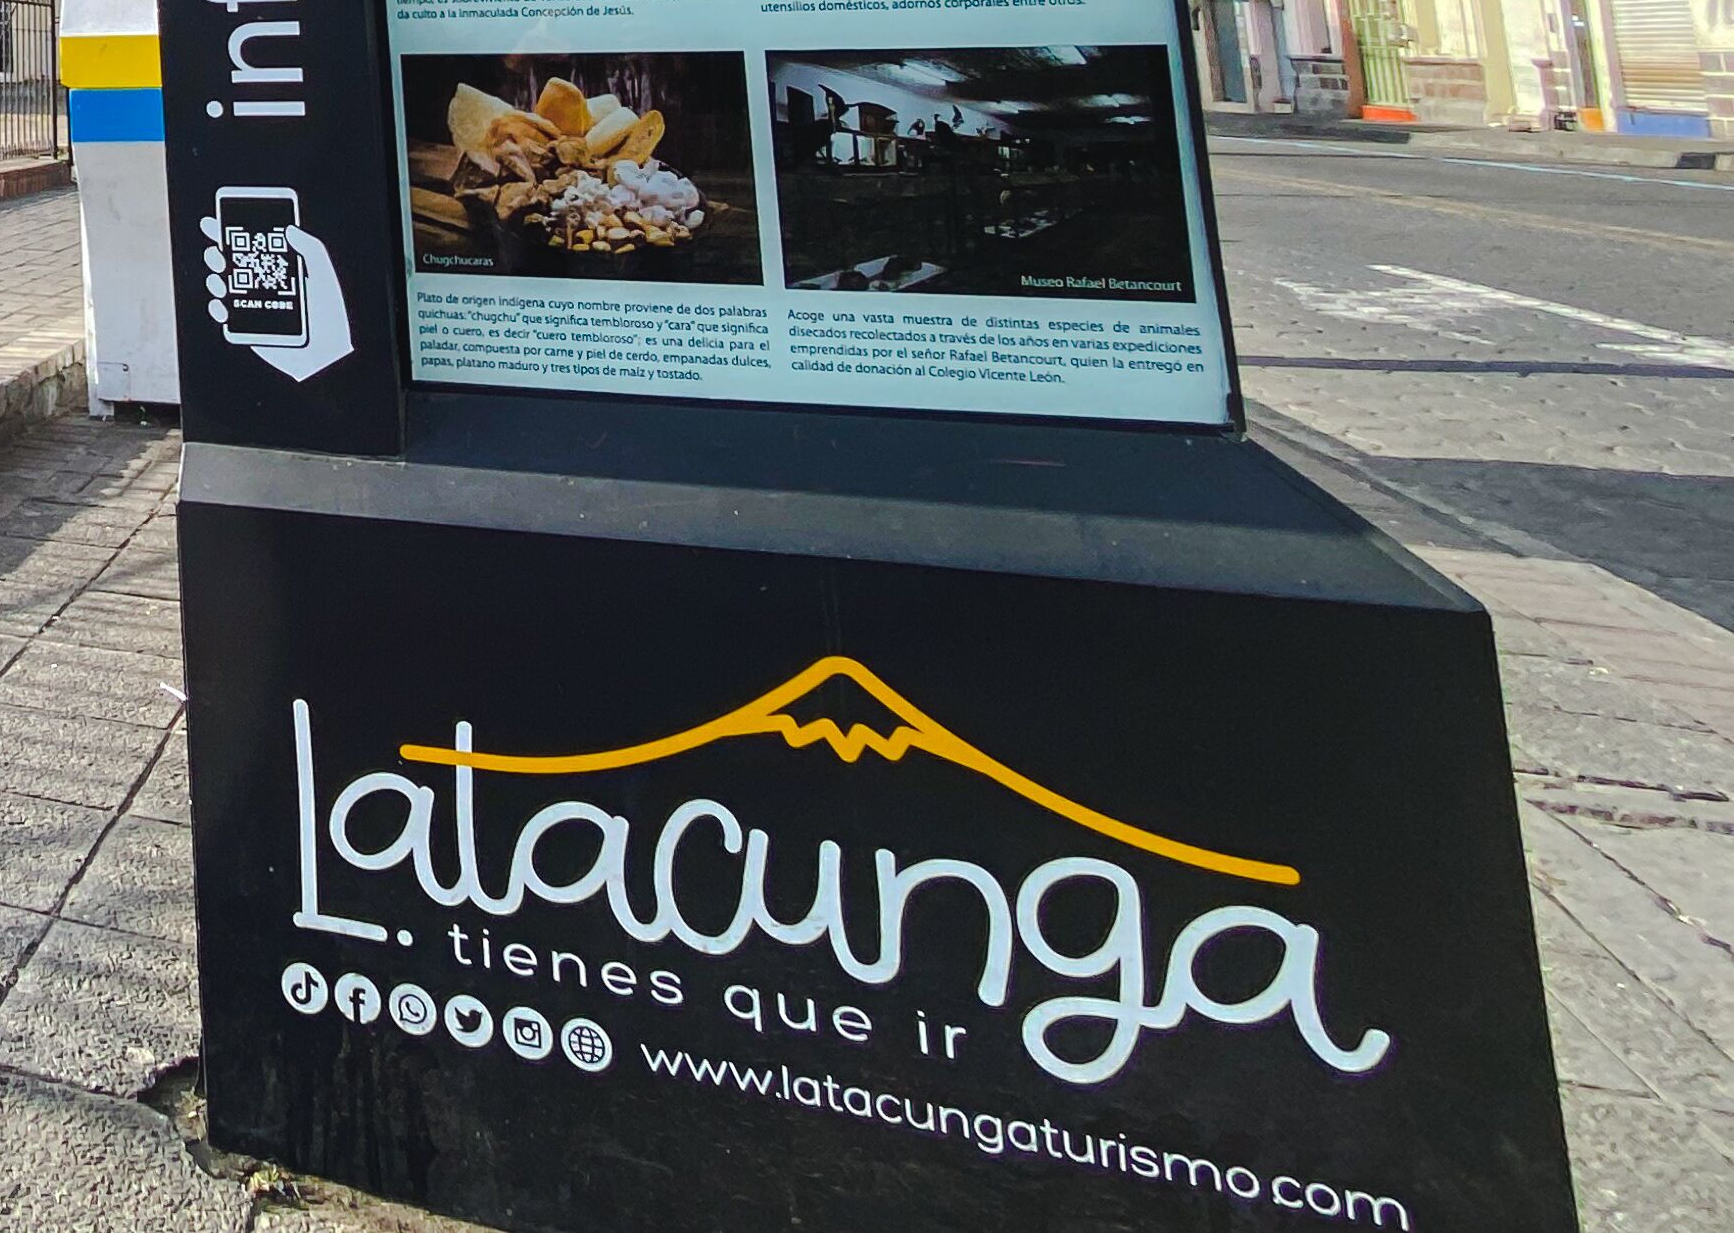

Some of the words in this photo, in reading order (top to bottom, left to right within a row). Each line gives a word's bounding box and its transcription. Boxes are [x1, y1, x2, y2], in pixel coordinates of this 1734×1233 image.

[412, 7, 437, 19] culto
[458, 6, 518, 19] Inmaculada
[520, 5, 584, 19] Concepción
[760, 0, 815, 13] utensilios
[422, 253, 494, 267] Chugchucaras
[1021, 275, 1064, 287] Museo
[1066, 277, 1106, 289] Rafael
[1109, 278, 1182, 291] Betancourt
[233, 299, 262, 308] SCAN
[416, 291, 442, 304] Plato
[461, 293, 495, 308] origen
[498, 294, 545, 310] indígena
[548, 300, 574, 312] cuyo
[577, 299, 620, 312] nombre
[624, 301, 673, 314] proviene
[694, 303, 715, 316] dos
[718, 305, 767, 319] palabras
[522, 314, 542, 326] que
[544, 313, 588, 327] significa
[590, 316, 654, 329] tembloroso
[696, 323, 718, 334] que
[721, 321, 768, 336] significa
[787, 308, 824, 323] Acoge
[832, 313, 855, 322] una
[862, 313, 894, 324] vasta
[902, 315, 953, 326] muestra
[985, 316, 1040, 330] distintas
[1048, 320, 1104, 334] especies
[1138, 323, 1200, 336] animales
[418, 322, 438, 337] piel
[503, 326, 530, 339] decir
[661, 337, 683, 347] una
[687, 336, 724, 349] delicia
[729, 341, 754, 352] para
[788, 324, 846, 339] disecados
[849, 328, 926, 342] recolectados
[938, 332, 976, 344] través
[997, 334, 1015, 346] los
[1018, 335, 1049, 348] años
[1071, 338, 1109, 350] varias
[1112, 340, 1201, 355] expediciones
[462, 343, 520, 356] compuesta
[523, 346, 541, 358] por
[544, 348, 573, 358] carne
[586, 347, 606, 361] piel
[662, 353, 728, 366] empanadas
[790, 344, 868, 357] emprendidas
[872, 348, 892, 360] por
[911, 348, 945, 360] señor
[949, 349, 987, 362] Rafael
[1070, 355, 1108, 369] quien
[1128, 359, 1182, 373] entregó
[456, 356, 495, 370] platano
[498, 359, 539, 372] maduro
[550, 362, 570, 374] tres
[572, 362, 600, 377] tipos
[619, 365, 645, 378] maíz
[791, 359, 834, 372] calidad
[855, 361, 912, 376] donación
[928, 365, 976, 381] Colegio
[978, 368, 1026, 382] Vicente
[292, 698, 1391, 1084] Latacunga
[447, 923, 684, 1005] tienes
[724, 983, 872, 1033] que
[916, 1009, 967, 1060] ir
[639, 1043, 1410, 1232] www.latacungaturismo.com
